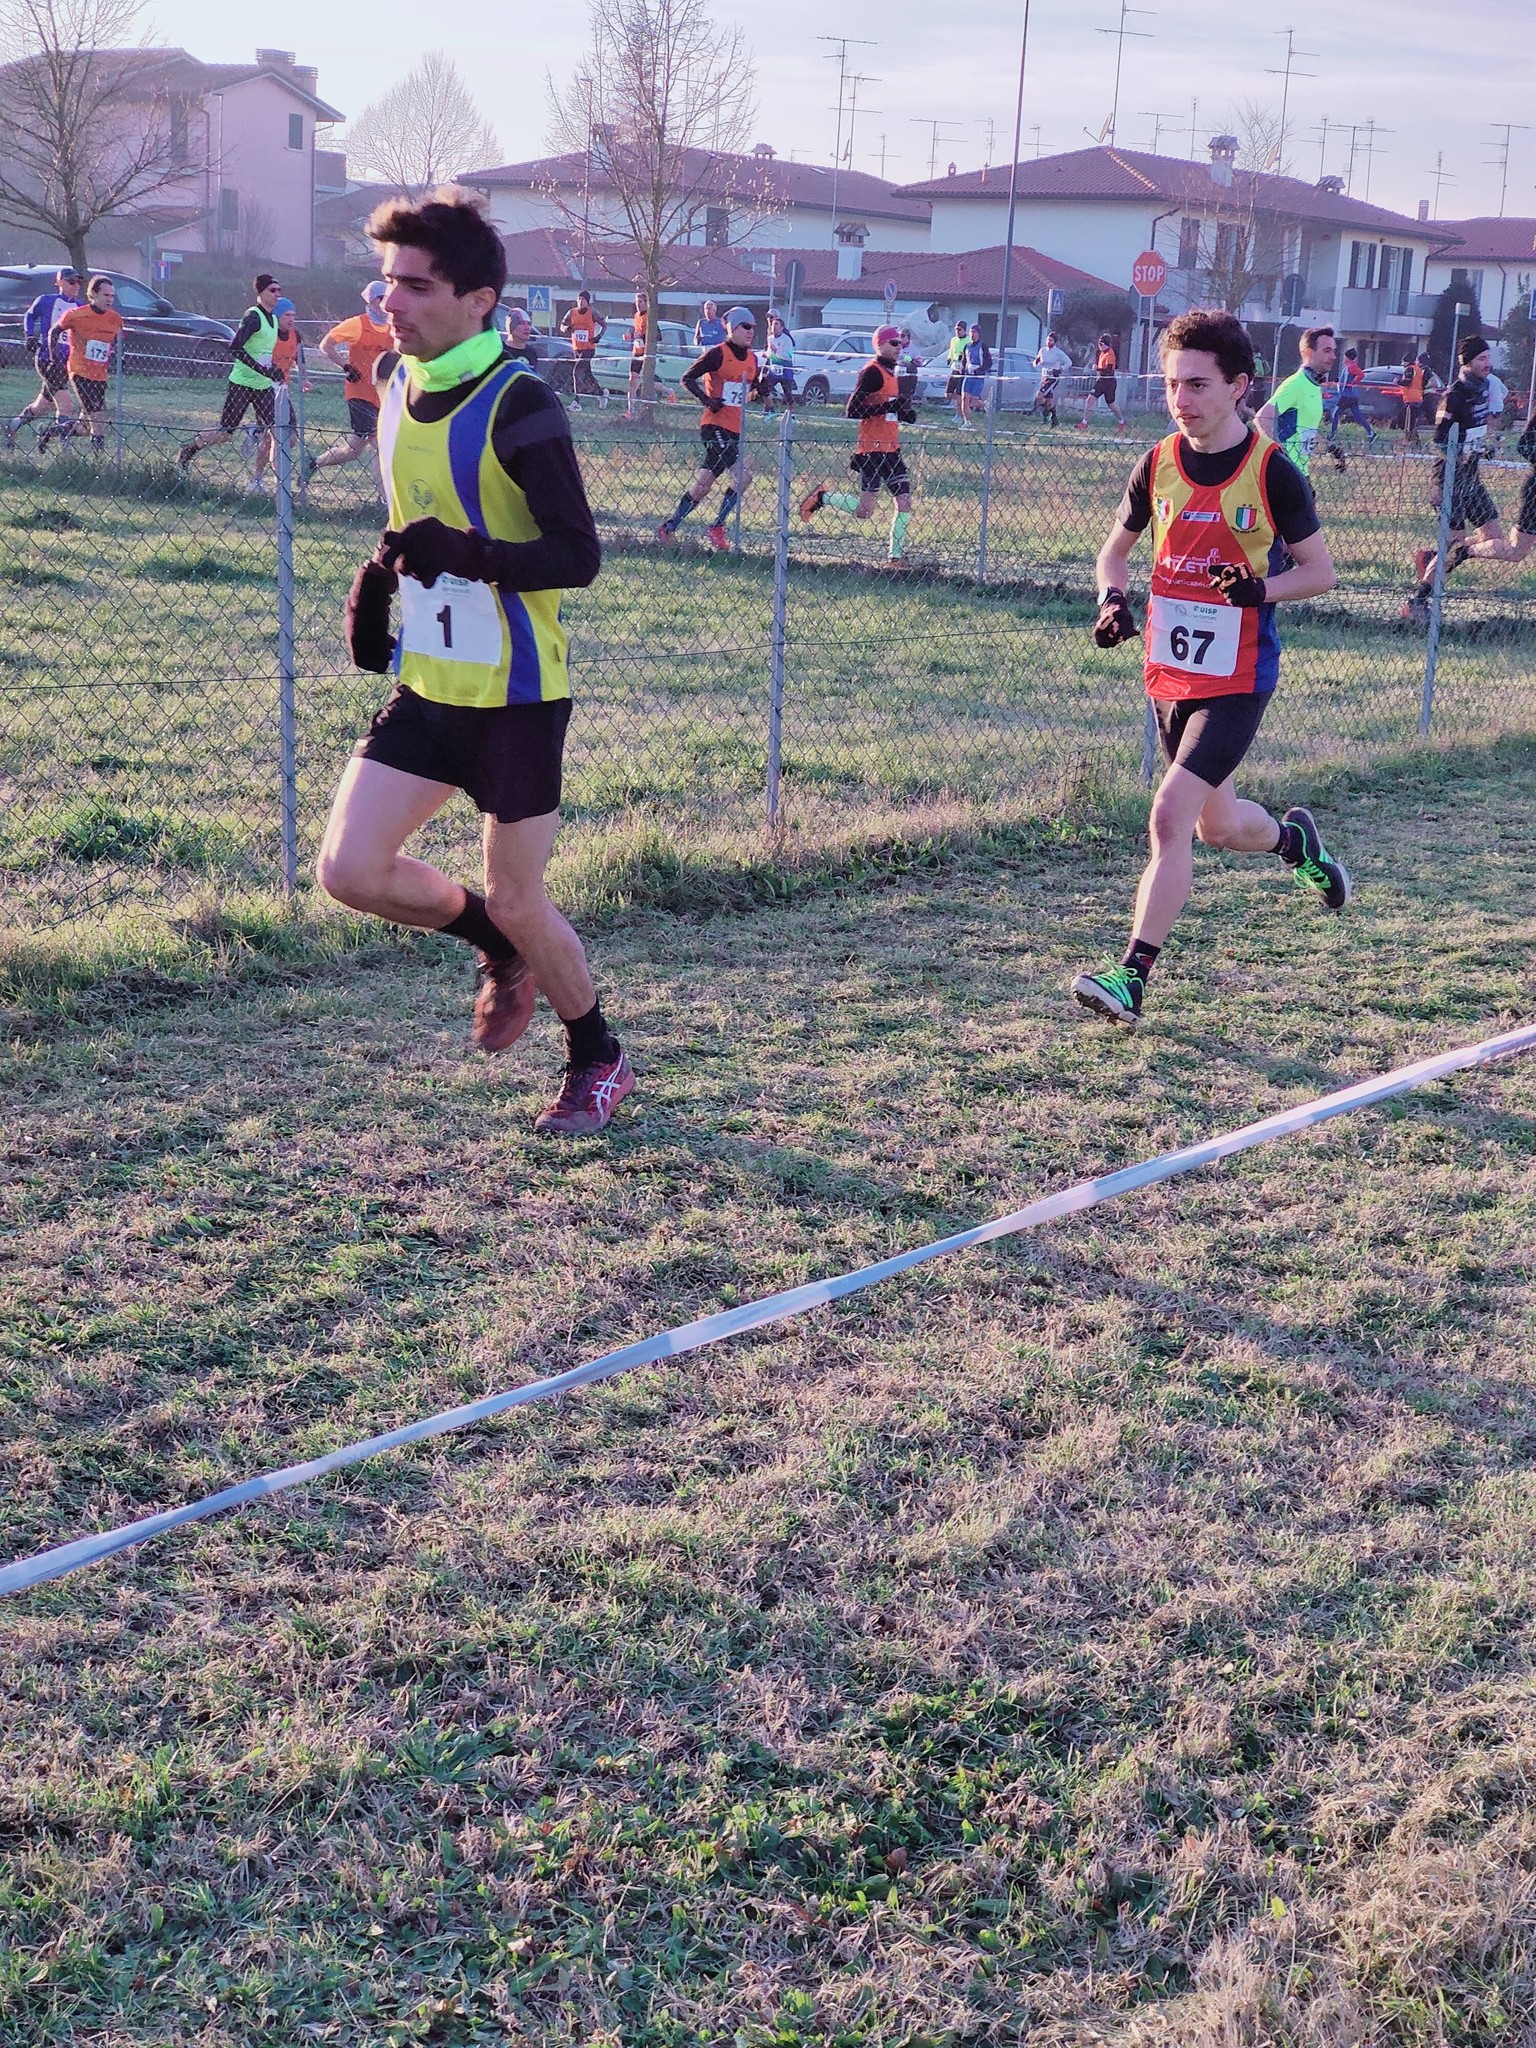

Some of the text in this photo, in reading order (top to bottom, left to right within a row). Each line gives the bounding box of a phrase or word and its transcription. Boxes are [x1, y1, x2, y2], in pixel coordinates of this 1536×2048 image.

[1134, 265, 1164, 282] STOP
[1199, 606, 1218, 615] UISP
[436, 604, 453, 649] 1
[1170, 625, 1216, 665] 67
